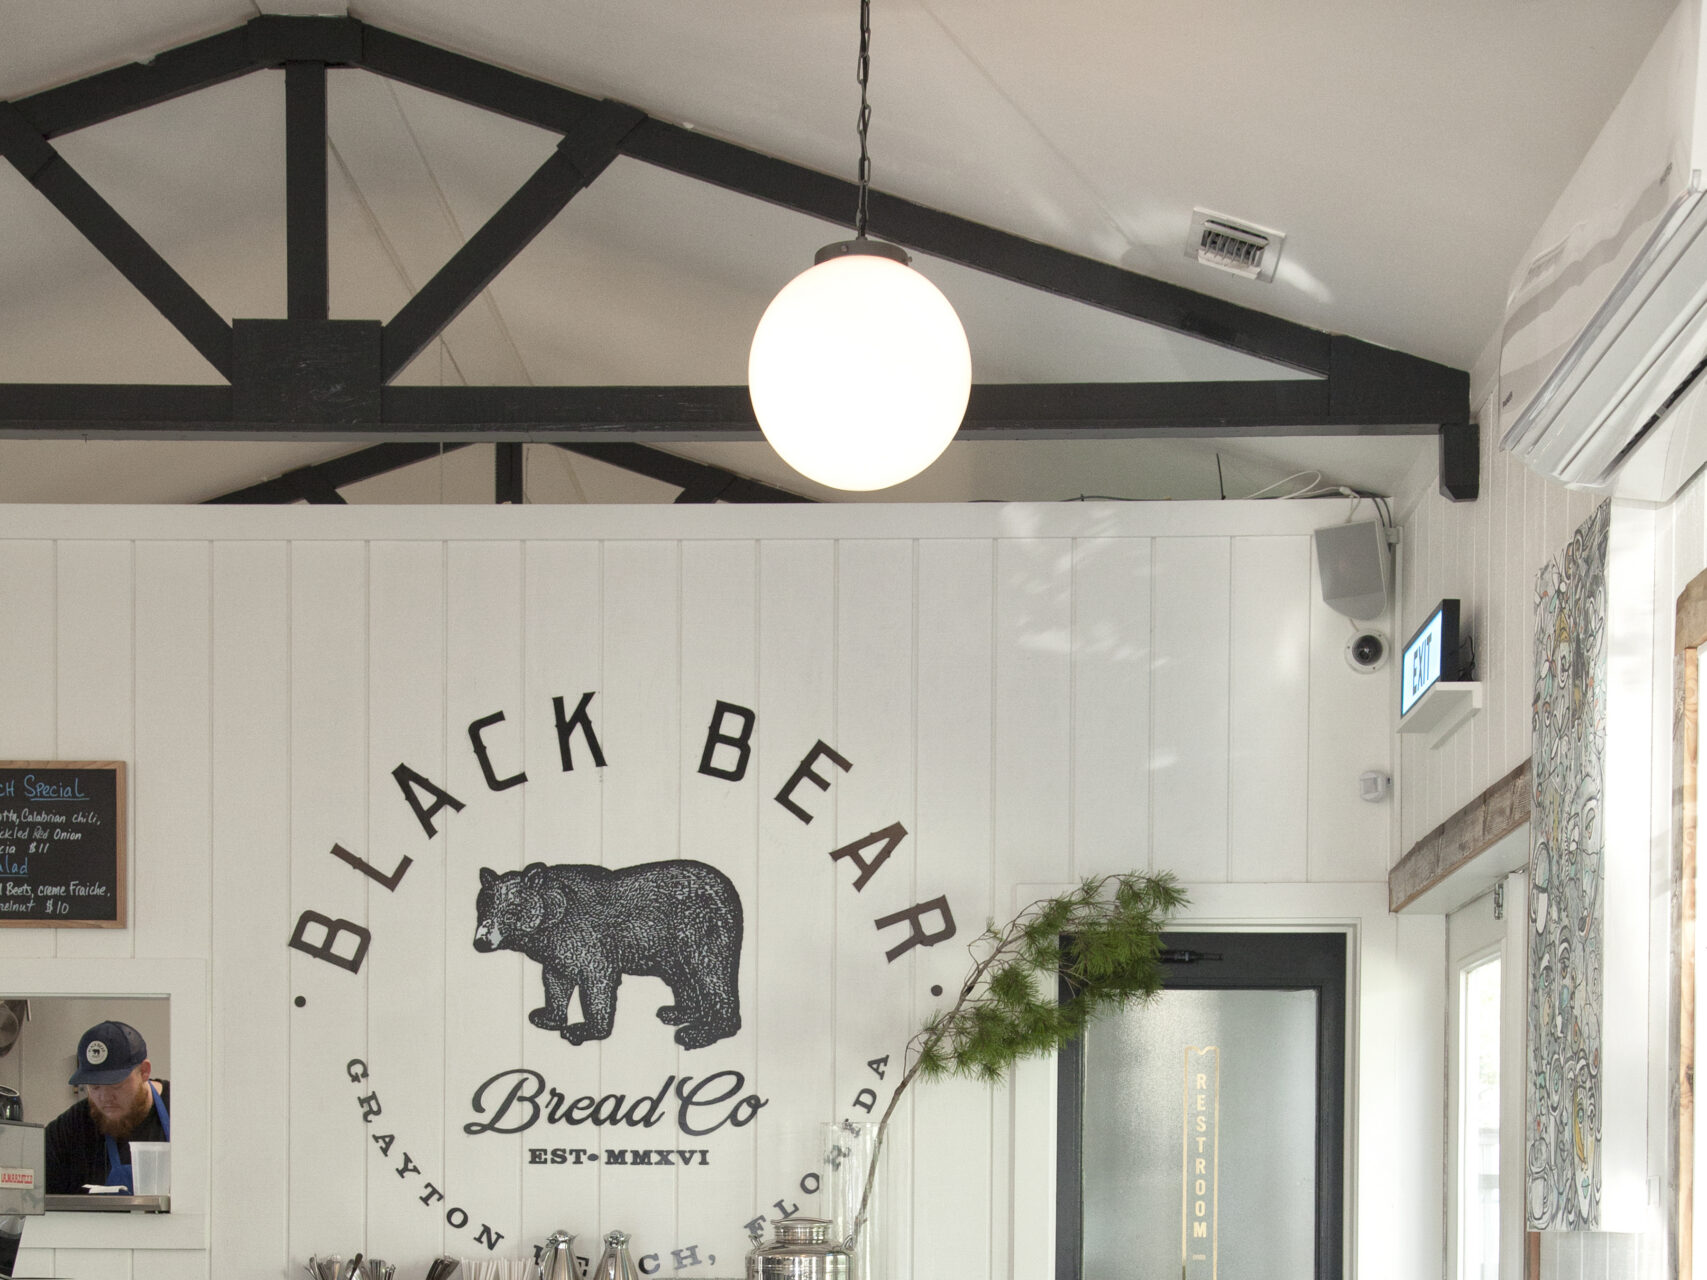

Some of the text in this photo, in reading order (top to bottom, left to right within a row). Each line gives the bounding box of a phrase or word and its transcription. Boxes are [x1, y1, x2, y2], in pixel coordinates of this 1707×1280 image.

[1412, 632, 1432, 696] EXIT
[28, 842, 49, 854] $11
[53, 828, 82, 840] Onion
[288, 691, 957, 974] BLACK BEAR
[45, 899, 69, 914] $10
[463, 1068, 769, 1137] Bread Co
[346, 1058, 505, 1251] GRAYTON
[1193, 1073, 1207, 1239] RESTROOM
